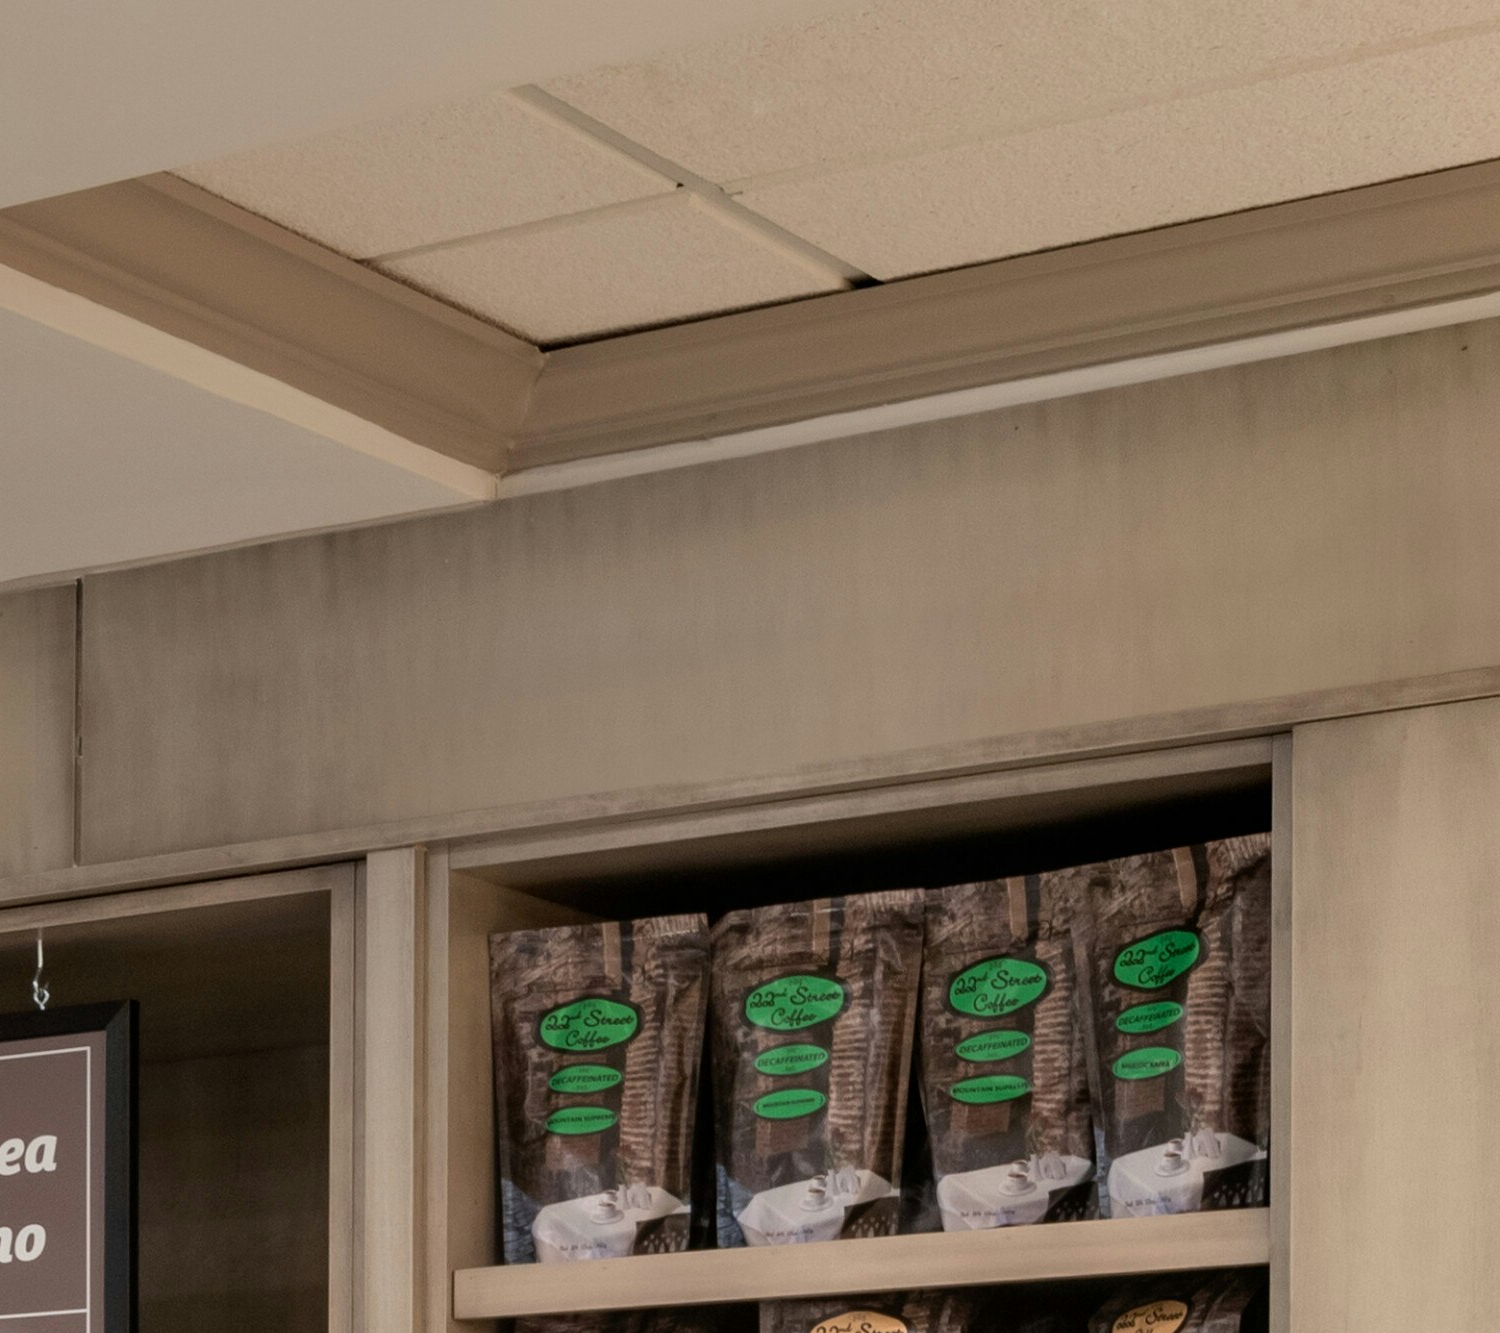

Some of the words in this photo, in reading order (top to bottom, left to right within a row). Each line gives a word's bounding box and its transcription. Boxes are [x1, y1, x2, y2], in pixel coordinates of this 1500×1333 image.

[991, 971, 1043, 989] Street
[790, 986, 841, 1004] Street
[973, 994, 1019, 1012] Coffee
[771, 1007, 817, 1024] Coffee
